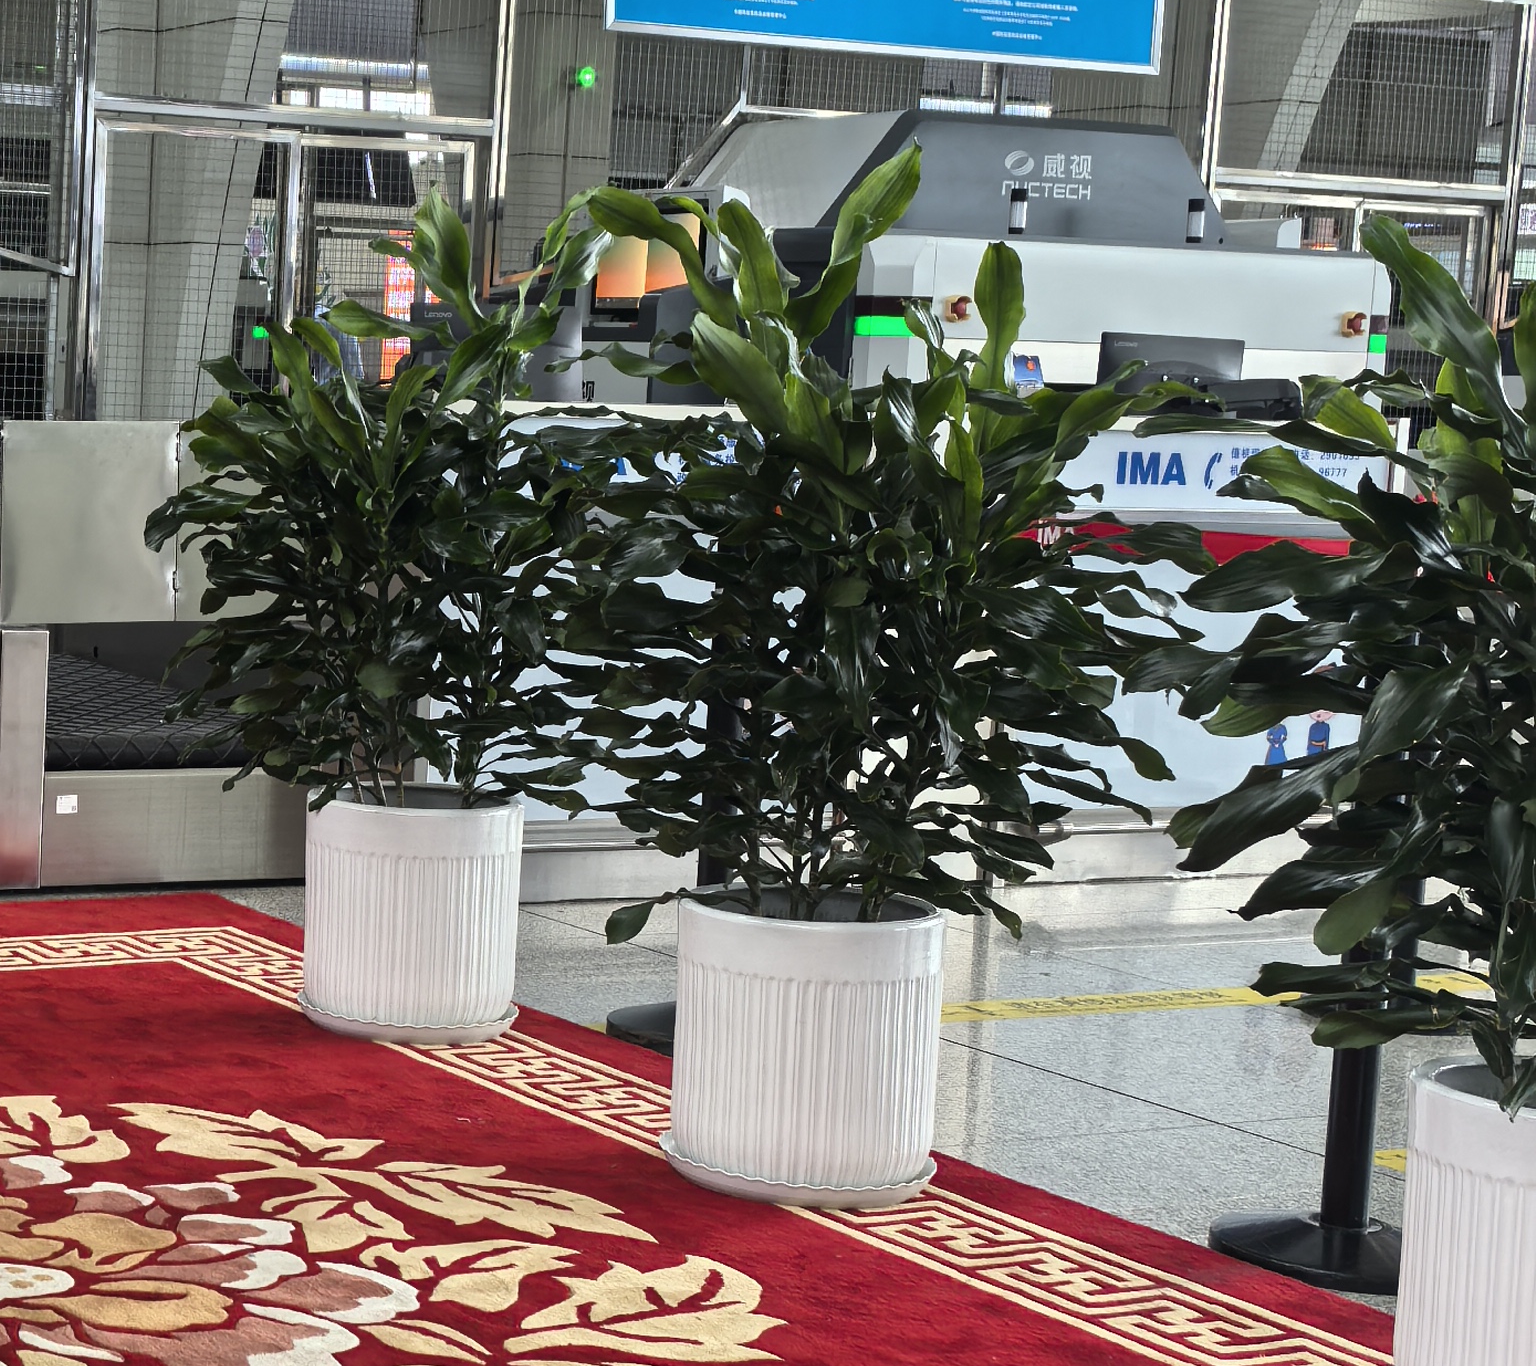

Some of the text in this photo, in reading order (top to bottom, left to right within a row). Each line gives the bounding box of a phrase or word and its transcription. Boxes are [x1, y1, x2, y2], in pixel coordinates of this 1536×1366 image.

[1042, 153, 1093, 180] 威视
[424, 310, 453, 318] Lenovo
[1116, 451, 1187, 486] IMA
